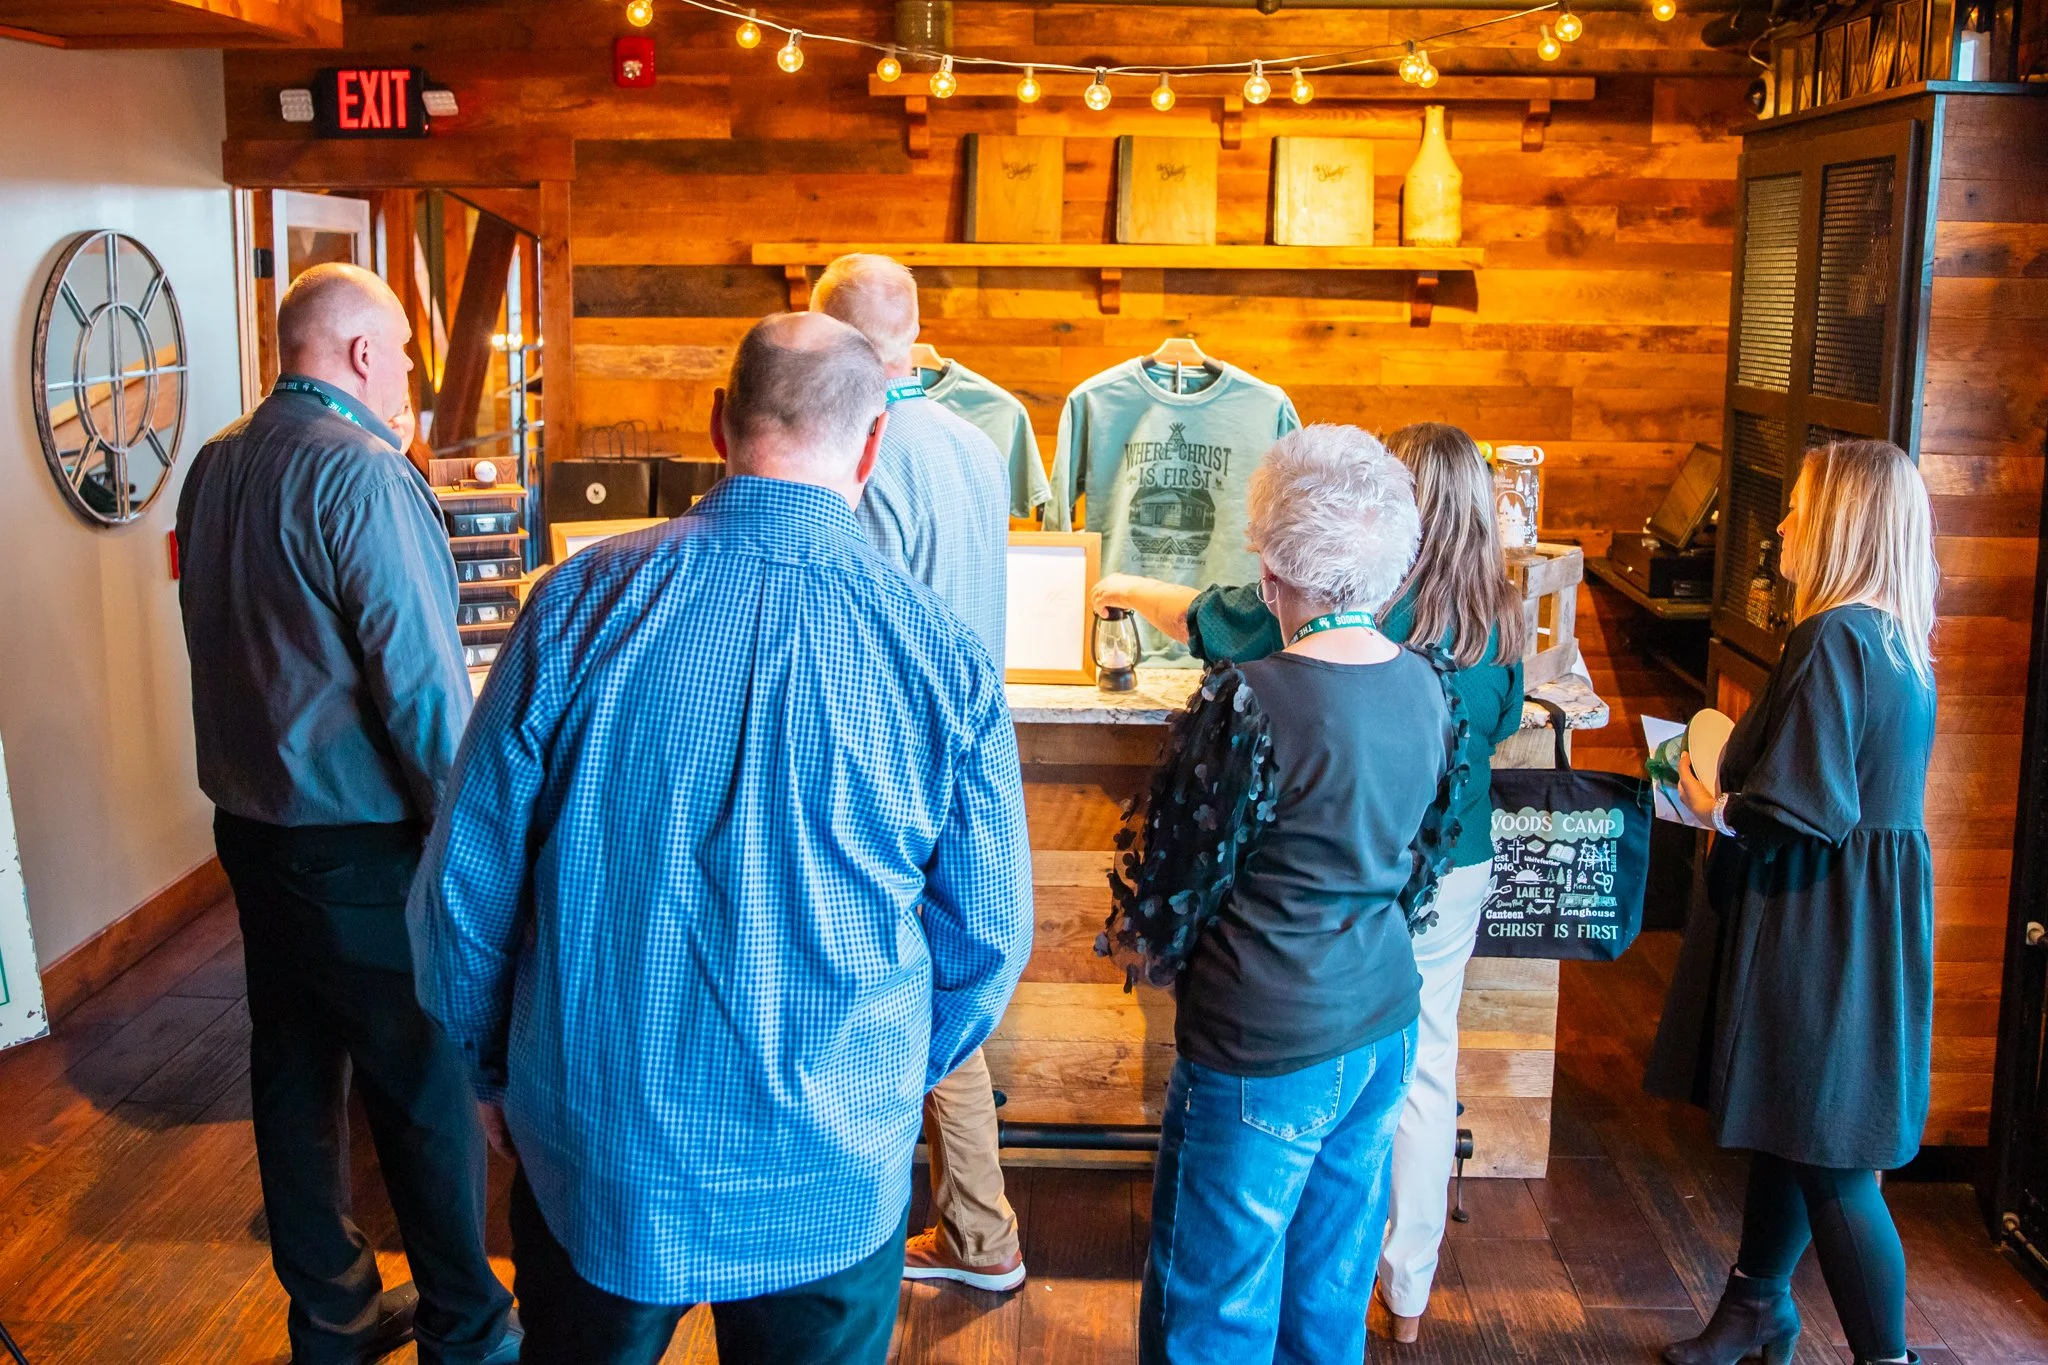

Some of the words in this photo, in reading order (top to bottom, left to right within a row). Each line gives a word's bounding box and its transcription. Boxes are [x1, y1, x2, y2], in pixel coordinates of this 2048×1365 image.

[337, 69, 411, 129] EXIT
[1125, 442, 1174, 470] WHERE
[1178, 444, 1232, 477] CHRIST
[1139, 468, 1156, 487] IS
[1163, 468, 1212, 489] FIRST
[1335, 614, 1362, 626] WOODS
[1298, 624, 1314, 638] THE
[1562, 817, 1616, 835] CAMP
[1494, 853, 1509, 862] est
[1494, 863, 1514, 872] 1946
[1564, 868, 1573, 892] camp
[1516, 886, 1541, 898] LAKE
[1544, 887, 1555, 898] 12
[1486, 909, 1524, 919] Canteen
[1560, 907, 1616, 918] Longhouse
[1487, 922, 1545, 938] CHRIST
[1554, 923, 1569, 938] IS
[1577, 924, 1618, 940] FIRST
